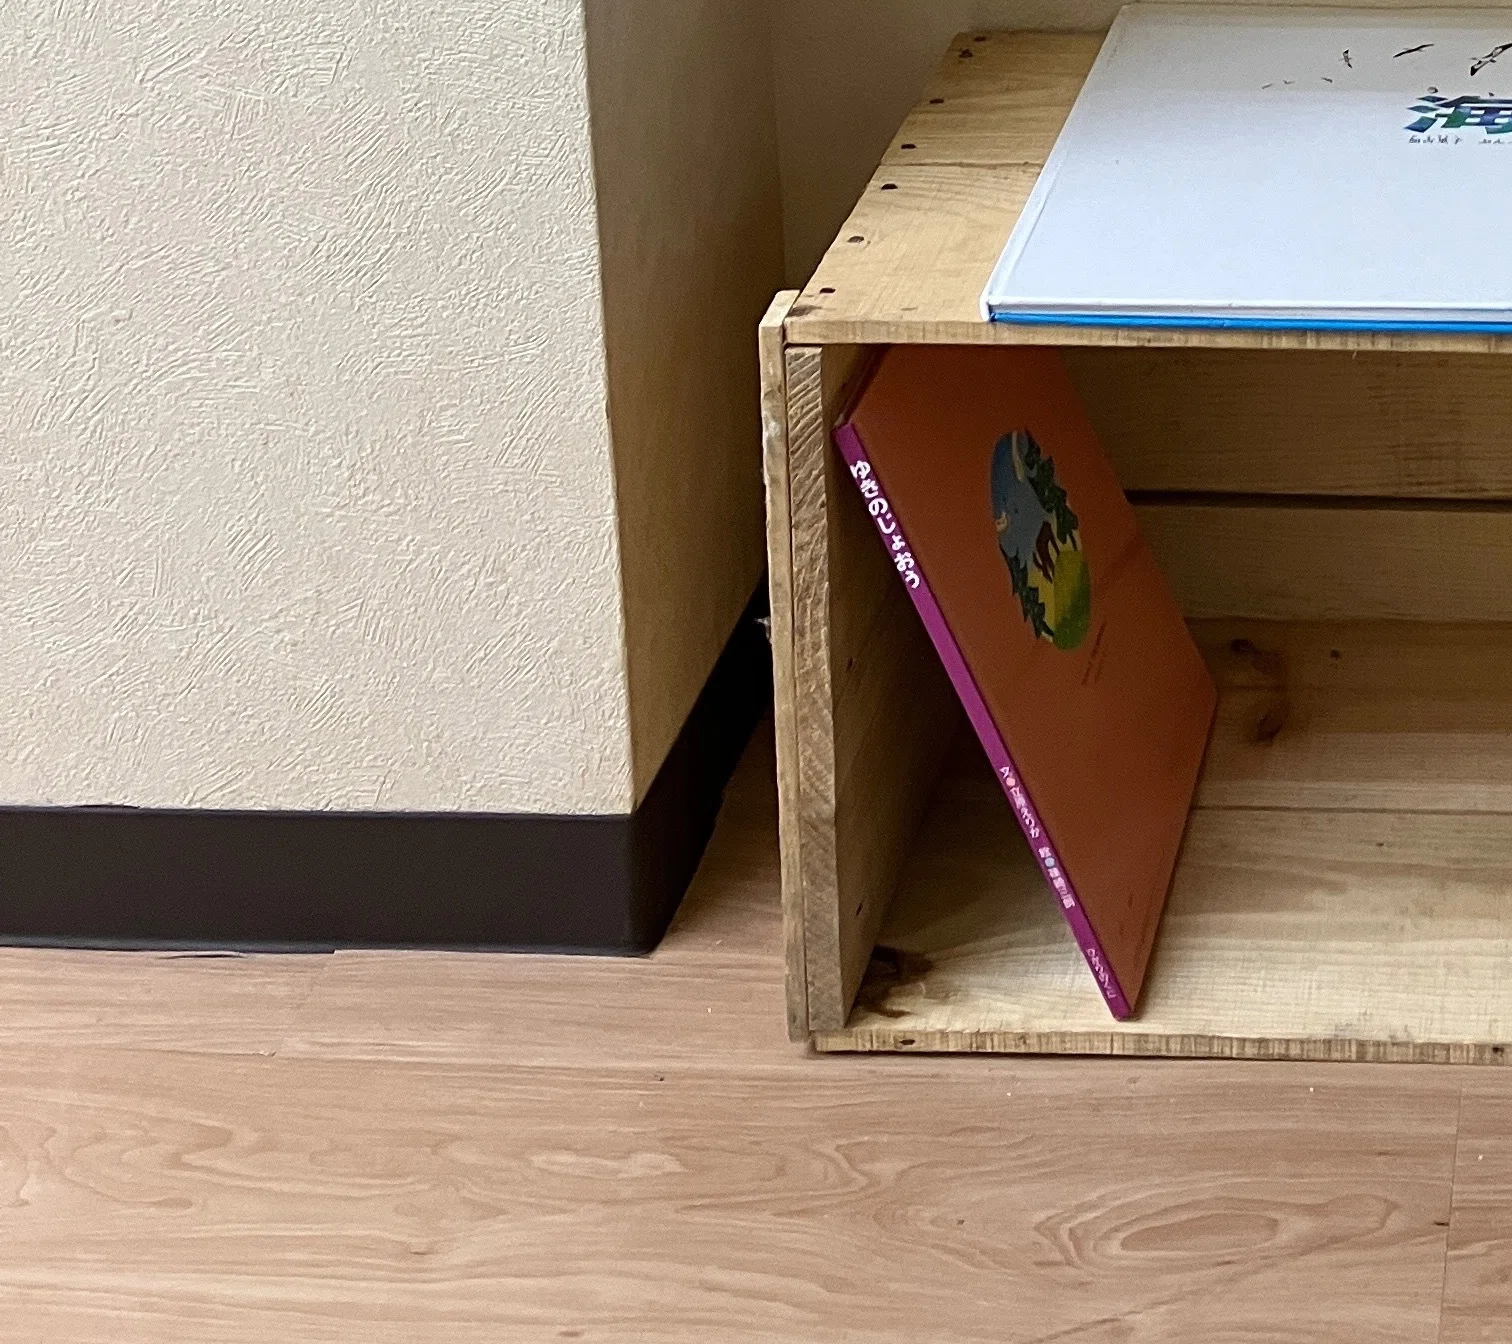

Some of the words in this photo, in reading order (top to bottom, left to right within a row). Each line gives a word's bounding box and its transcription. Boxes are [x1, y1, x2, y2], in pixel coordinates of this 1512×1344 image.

[849, 458, 921, 590] ゆきのじょおう
